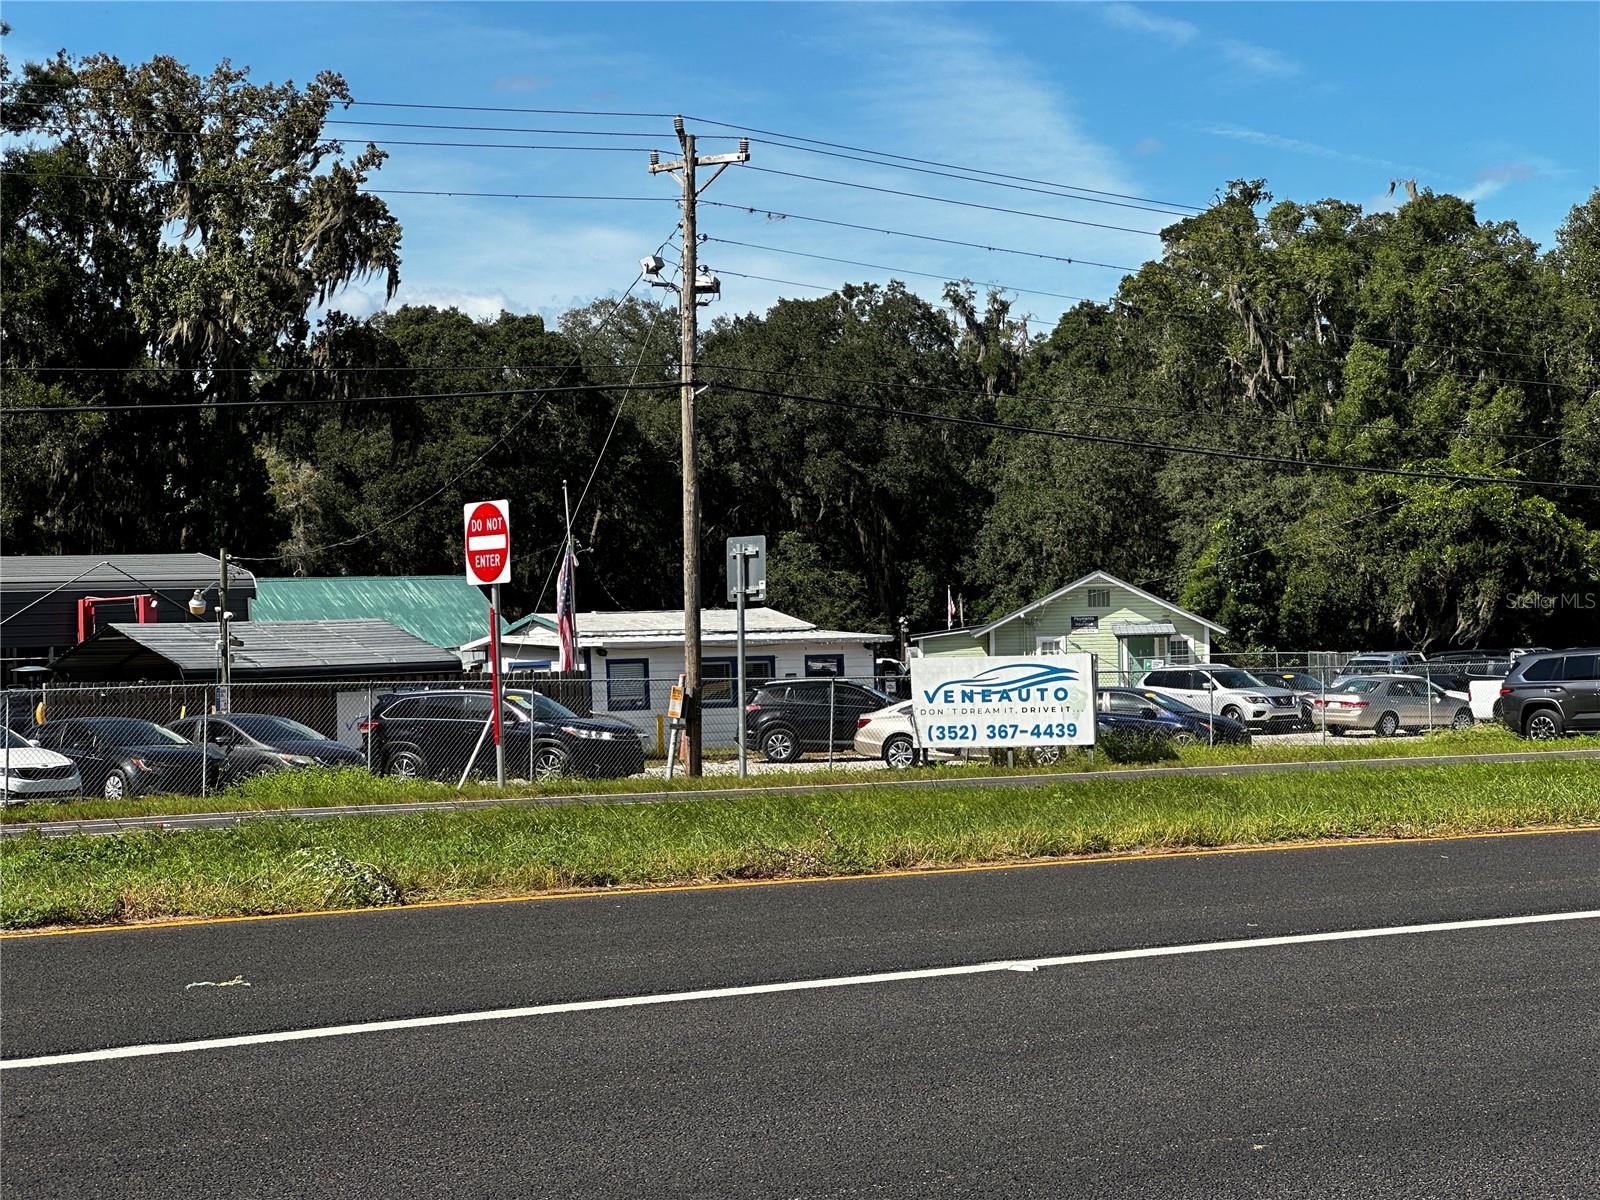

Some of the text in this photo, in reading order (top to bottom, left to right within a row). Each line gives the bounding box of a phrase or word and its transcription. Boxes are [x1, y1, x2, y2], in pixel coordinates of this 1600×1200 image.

[471, 517, 503, 532] DO NOT
[475, 553, 501, 568] ENTER
[923, 687, 1069, 704] VENEAUTO
[961, 707, 1000, 715] DREAM
[1021, 706, 1057, 714] DRIVE
[927, 723, 1078, 742] (352) 367-4439
